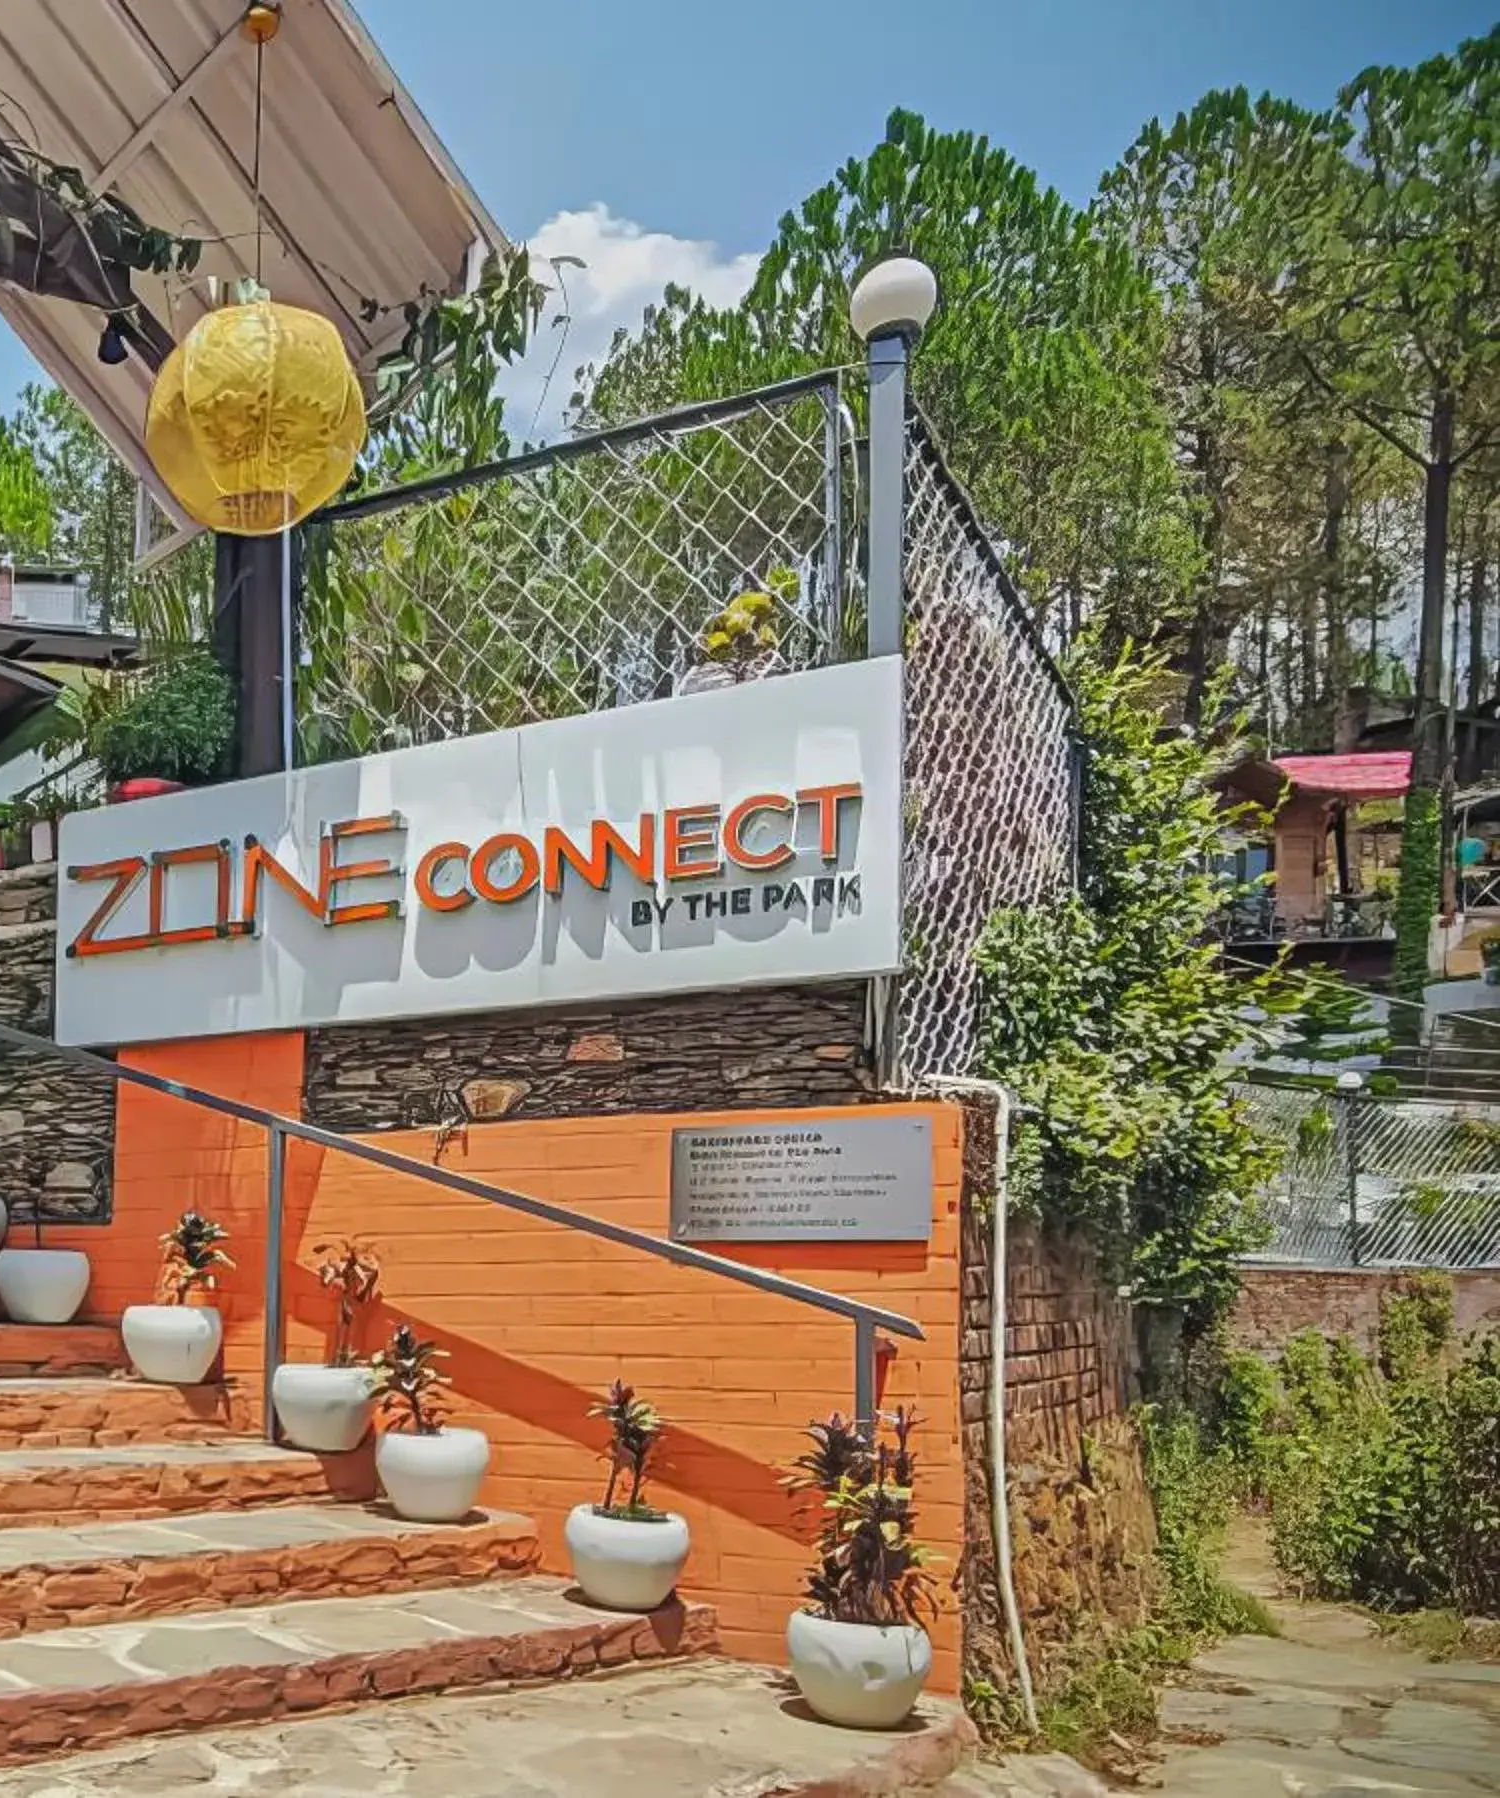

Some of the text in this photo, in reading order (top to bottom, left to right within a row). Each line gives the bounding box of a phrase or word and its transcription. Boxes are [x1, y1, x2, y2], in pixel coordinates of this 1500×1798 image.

[66, 782, 864, 959] ZONE CONNECT
[631, 873, 863, 927] BY THE PARK
